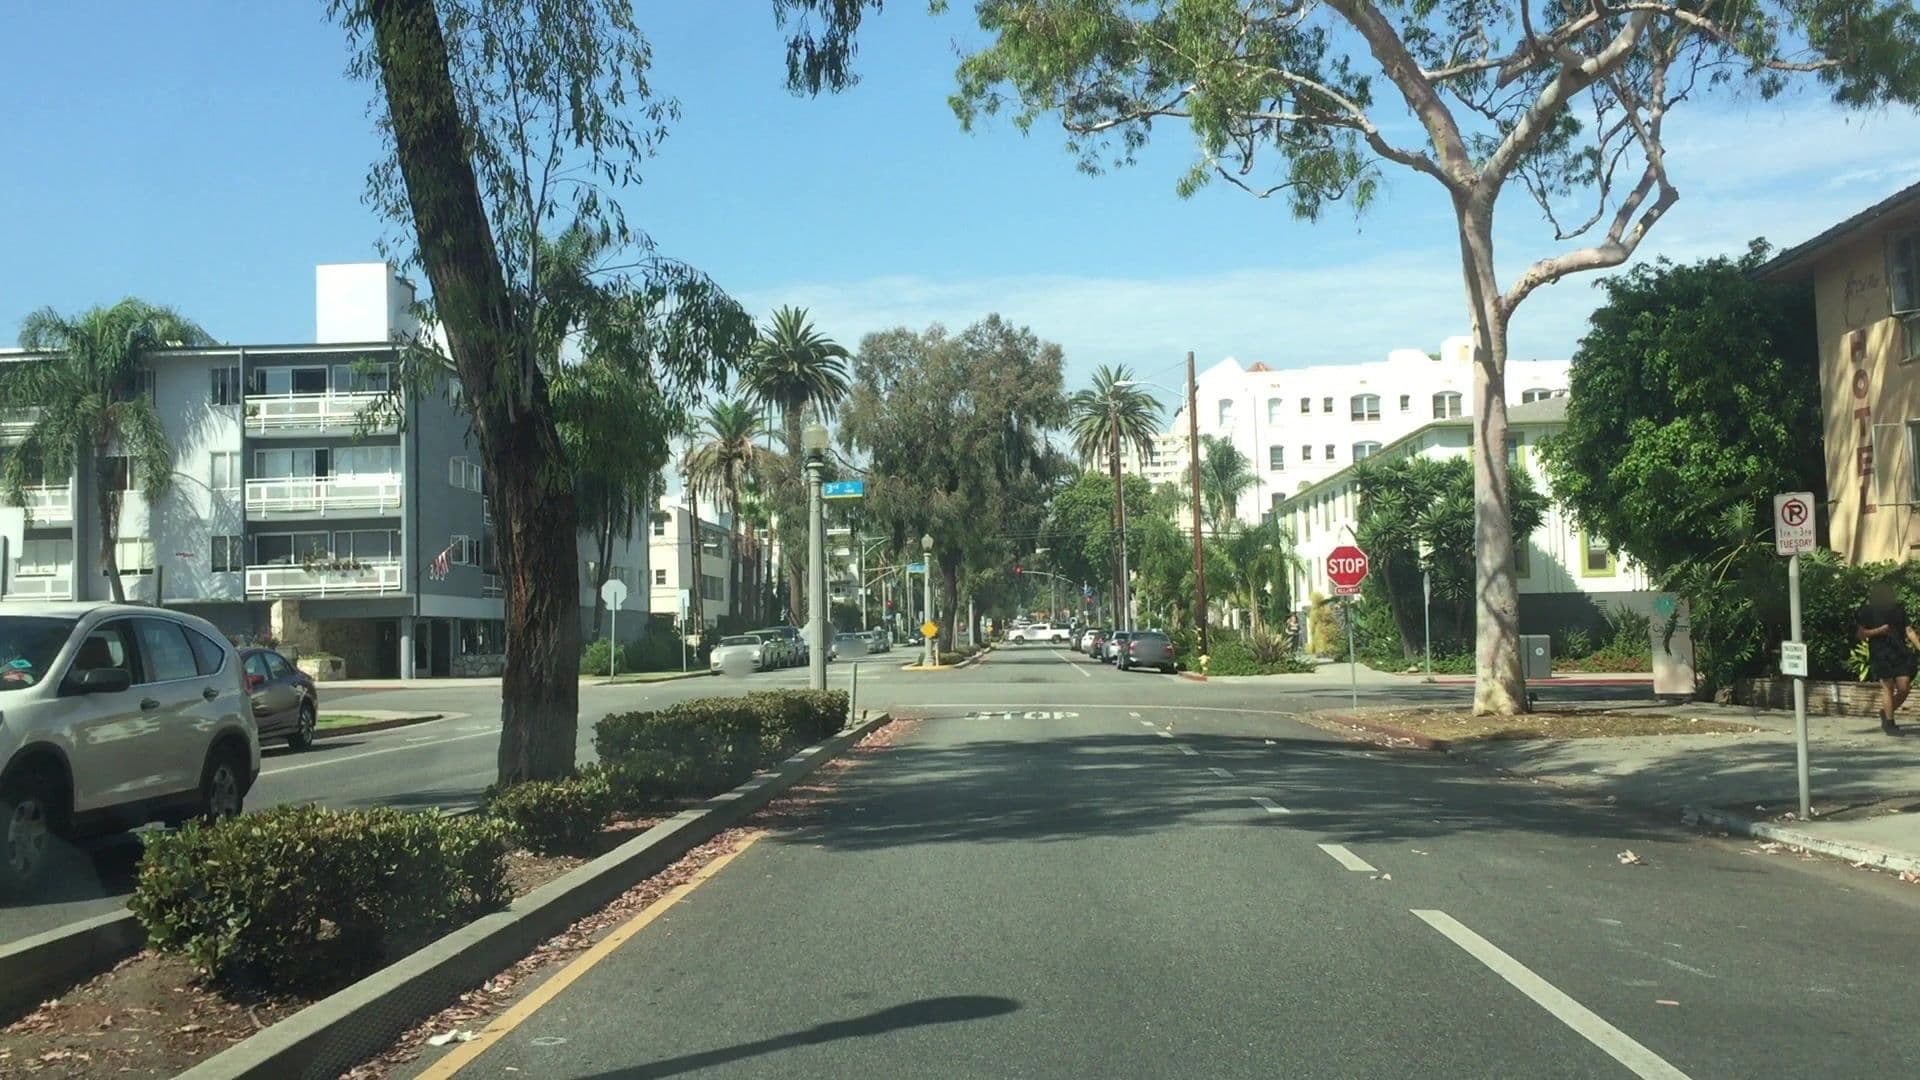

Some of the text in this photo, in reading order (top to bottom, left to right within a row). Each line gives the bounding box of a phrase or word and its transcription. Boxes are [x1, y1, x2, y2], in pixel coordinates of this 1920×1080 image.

[1850, 328, 1877, 514] HOTEL
[1779, 539, 1813, 549] TUESDAY
[1329, 558, 1365, 574] STOP
[963, 711, 1080, 720] STOP
